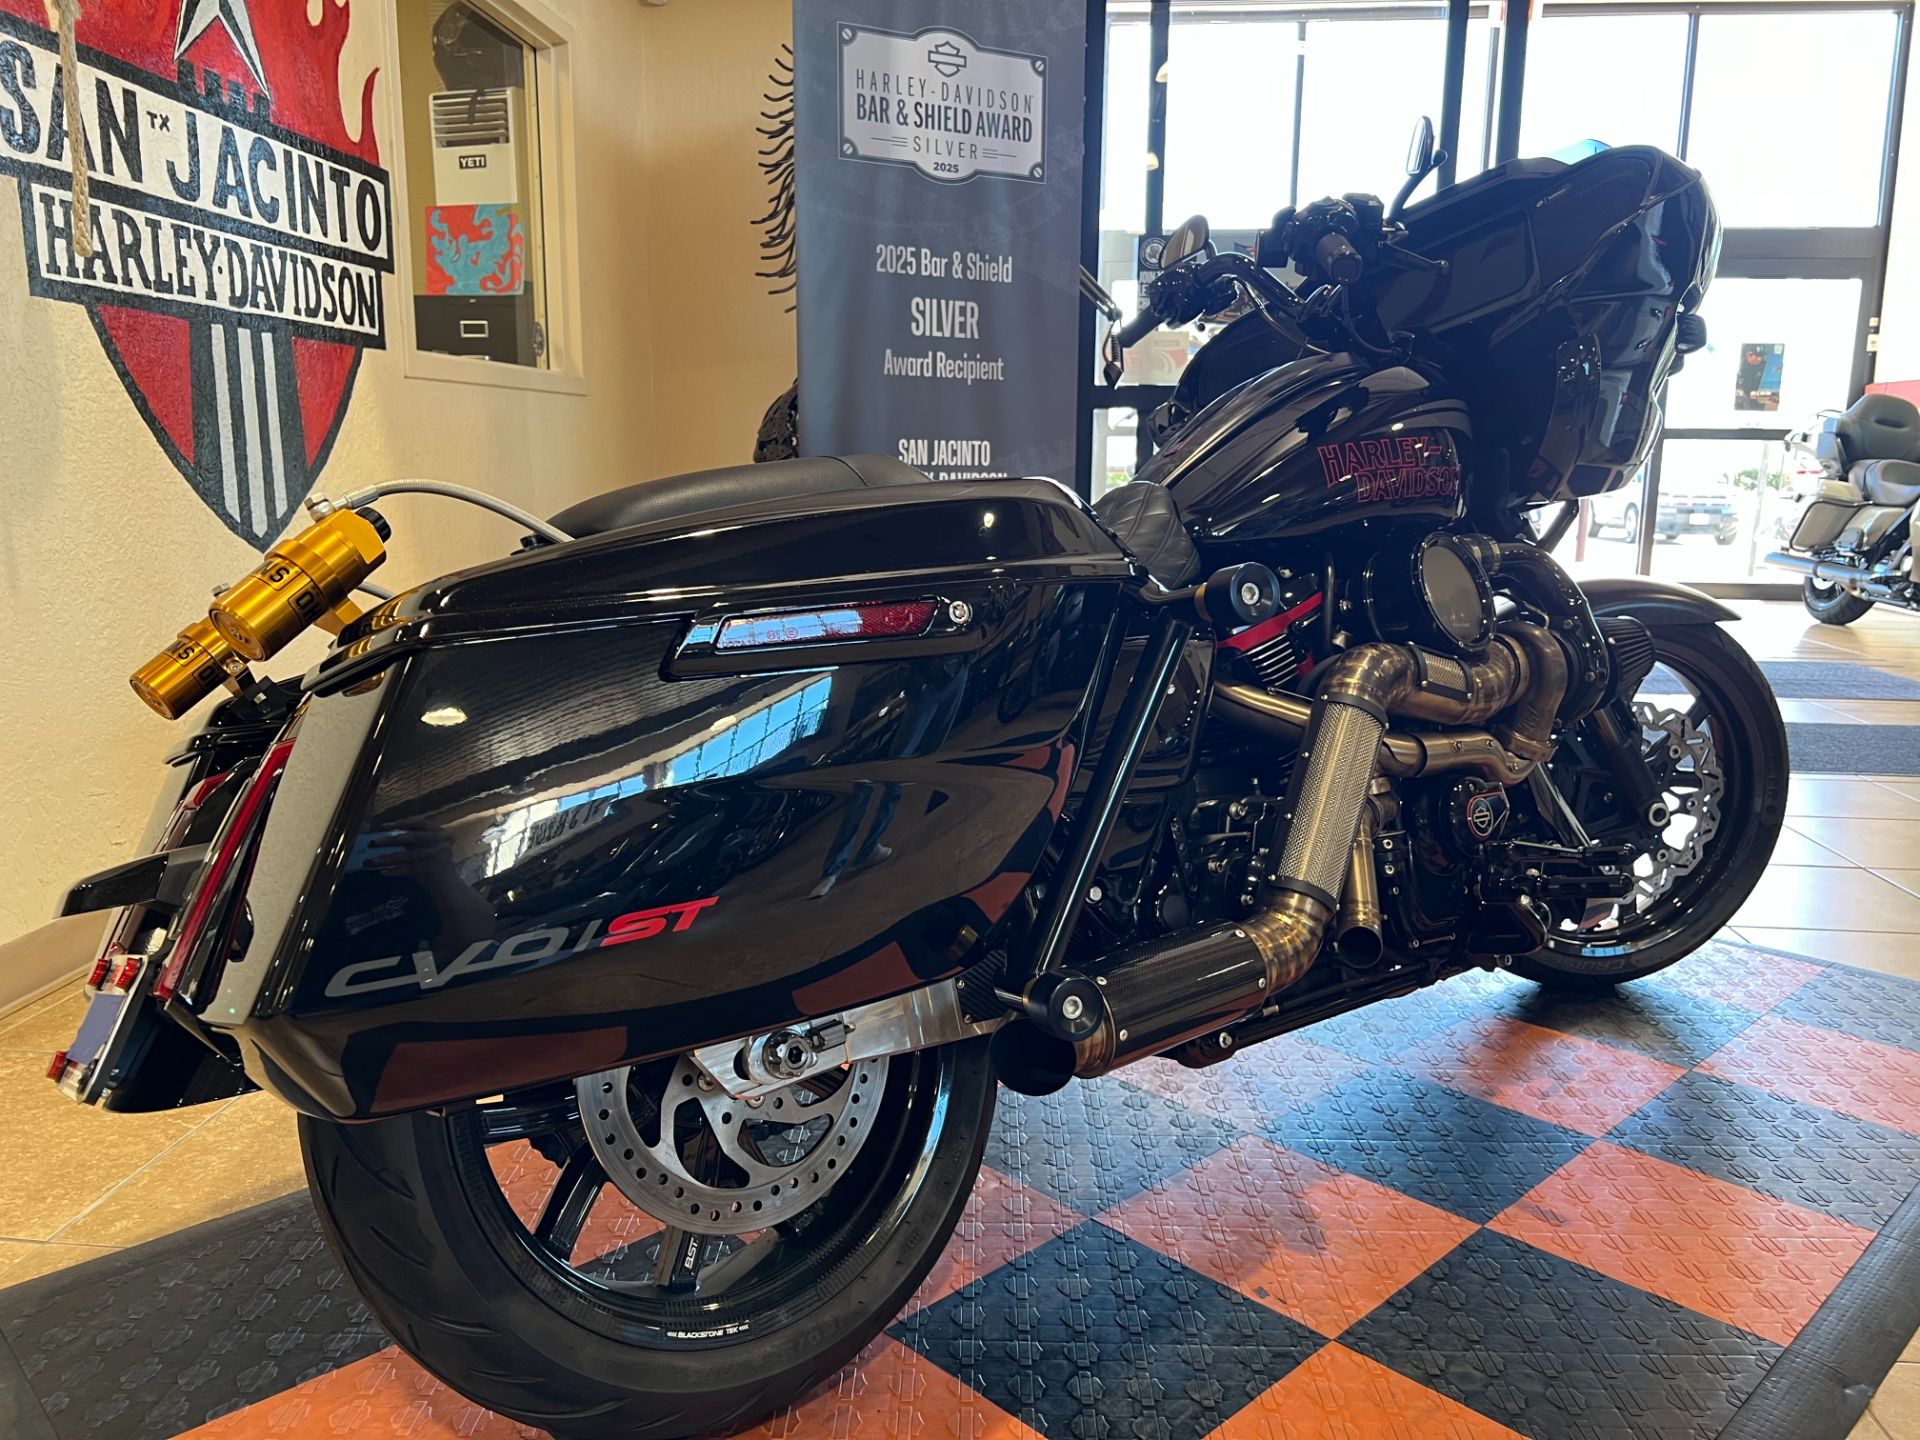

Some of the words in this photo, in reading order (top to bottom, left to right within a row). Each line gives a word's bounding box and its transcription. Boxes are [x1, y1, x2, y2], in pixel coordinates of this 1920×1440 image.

[856, 68, 1032, 113] HARLEY-DAVIDSON
[856, 93, 890, 124] BAR
[896, 98, 909, 126] &
[913, 101, 972, 134] SHIELD
[976, 111, 1033, 143] AWARD
[460, 157, 484, 167] YETI
[913, 136, 978, 160] SILVER
[146, 110, 171, 132] TX
[167, 111, 382, 251] JACINTO
[933, 161, 959, 173] 2025
[876, 244, 917, 275] 2025
[920, 248, 949, 277] Bar
[952, 251, 963, 279] &
[966, 252, 1013, 283] Shield
[911, 297, 979, 339] SILVER
[884, 349, 932, 377] Award
[936, 351, 1004, 385] Recipient
[898, 438, 928, 466] SAN
[931, 440, 991, 466] JACINTO
[1356, 465, 1461, 502] DAVIDSON
[678, 1329, 724, 1339] BLACKSTONE
[726, 1327, 738, 1335] TEK
